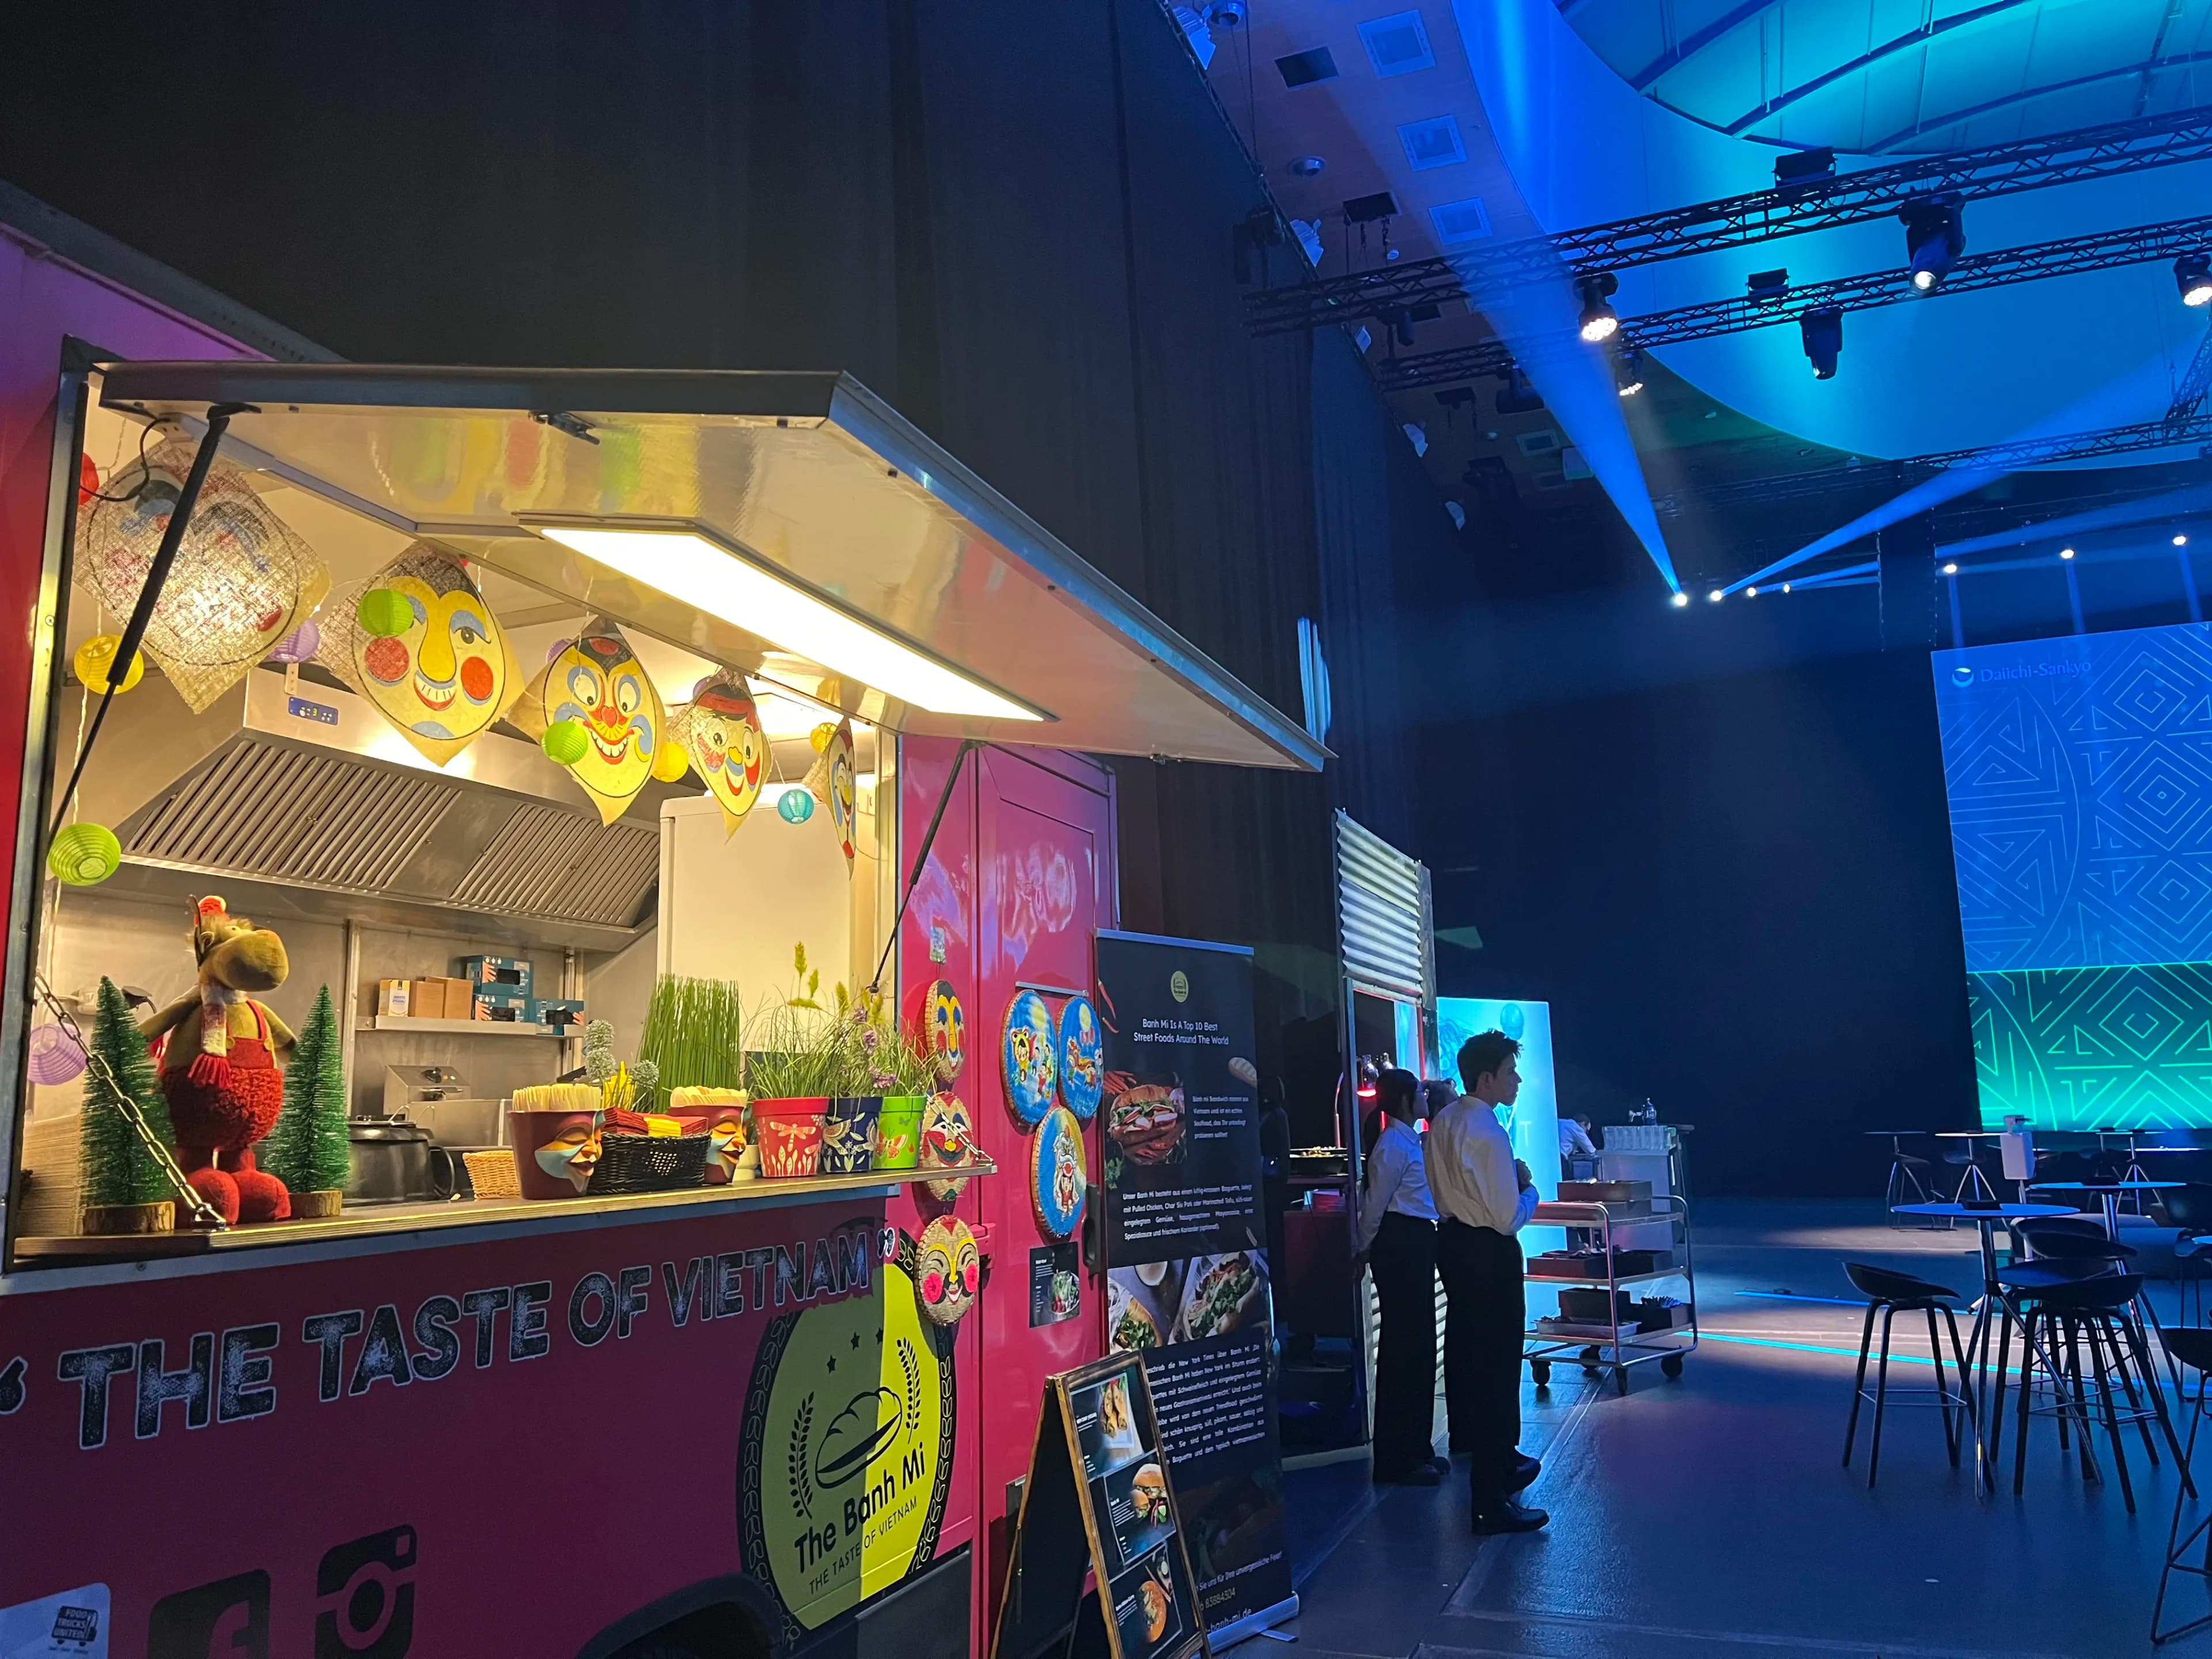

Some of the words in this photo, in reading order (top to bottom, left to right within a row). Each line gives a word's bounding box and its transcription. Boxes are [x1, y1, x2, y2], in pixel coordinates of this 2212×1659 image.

[1979, 660, 2092, 682] Daiichi-Sankyo
[1134, 1032, 1153, 1041] Street
[1154, 1033, 1175, 1043] Foods
[1176, 1035, 1197, 1044] Around
[1198, 1035, 1210, 1044] The
[1211, 1036, 1229, 1045] World
[1142, 1018, 1159, 1028] Banh
[1161, 1020, 1169, 1028] Mi
[1170, 1020, 1176, 1029] Is
[1183, 1021, 1194, 1032] Top
[1195, 1022, 1203, 1030] 10
[1204, 1022, 1218, 1031] Best
[58, 1323, 281, 1450] THE
[302, 1280, 552, 1403] TASTE
[568, 1266, 652, 1347] OF
[662, 1230, 869, 1328] VIETNAM
[794, 1522, 836, 1574] The
[843, 1468, 896, 1537] Banh
[902, 1441, 926, 1492] Mi
[809, 1569, 830, 1594] THE
[832, 1541, 861, 1576] TASTE
[863, 1529, 876, 1549] OF
[878, 1495, 917, 1536] VIETNAM
